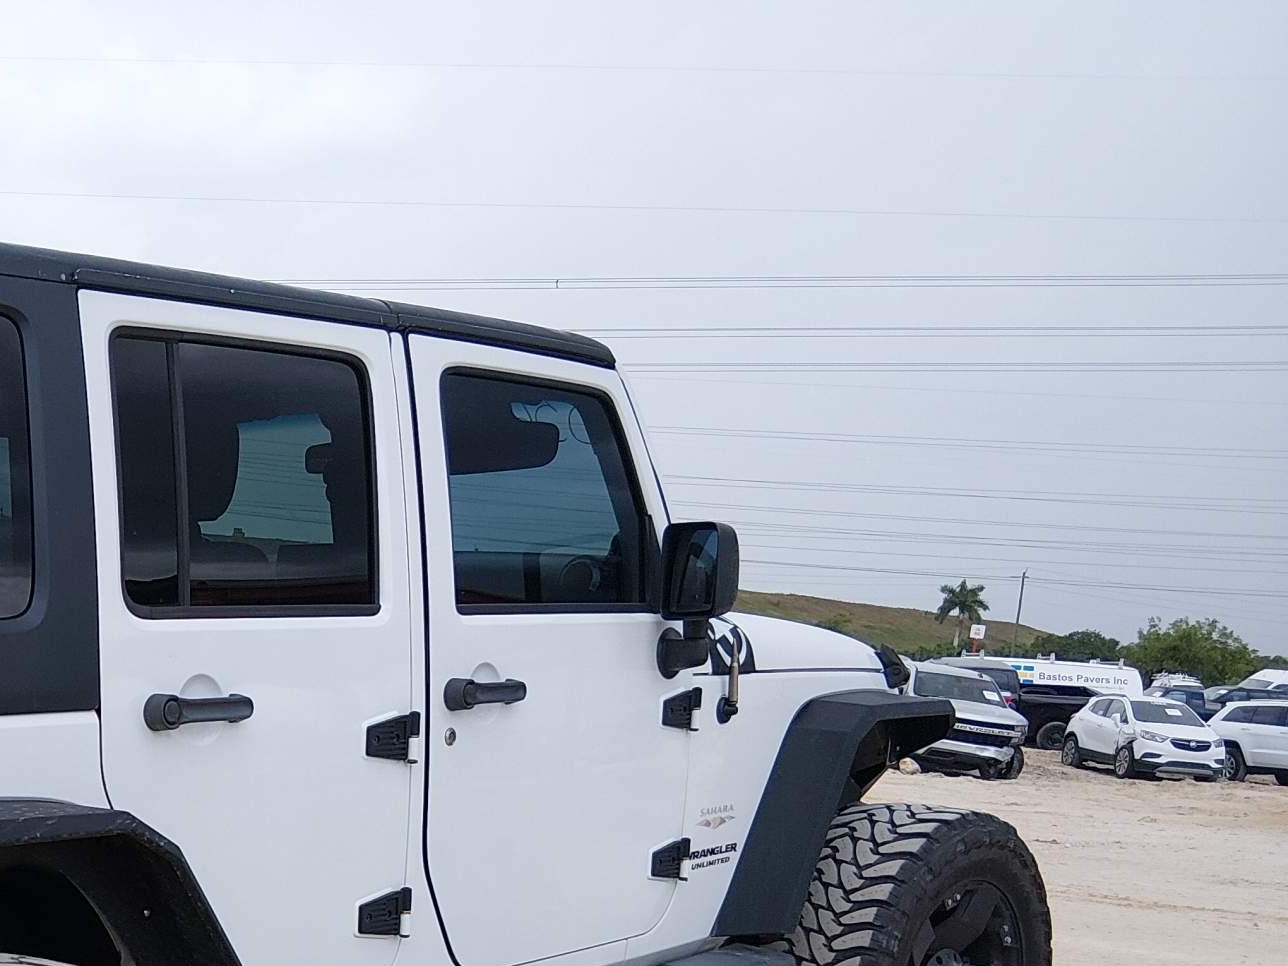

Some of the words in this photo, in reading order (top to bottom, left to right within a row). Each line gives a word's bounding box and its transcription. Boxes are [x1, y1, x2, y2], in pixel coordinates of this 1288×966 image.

[1039, 672, 1073, 682] Bastos
[1076, 674, 1111, 685] Pavers
[1113, 676, 1128, 686] Inc
[700, 804, 734, 817] SAHARA
[691, 857, 730, 871] UNLIMITED
